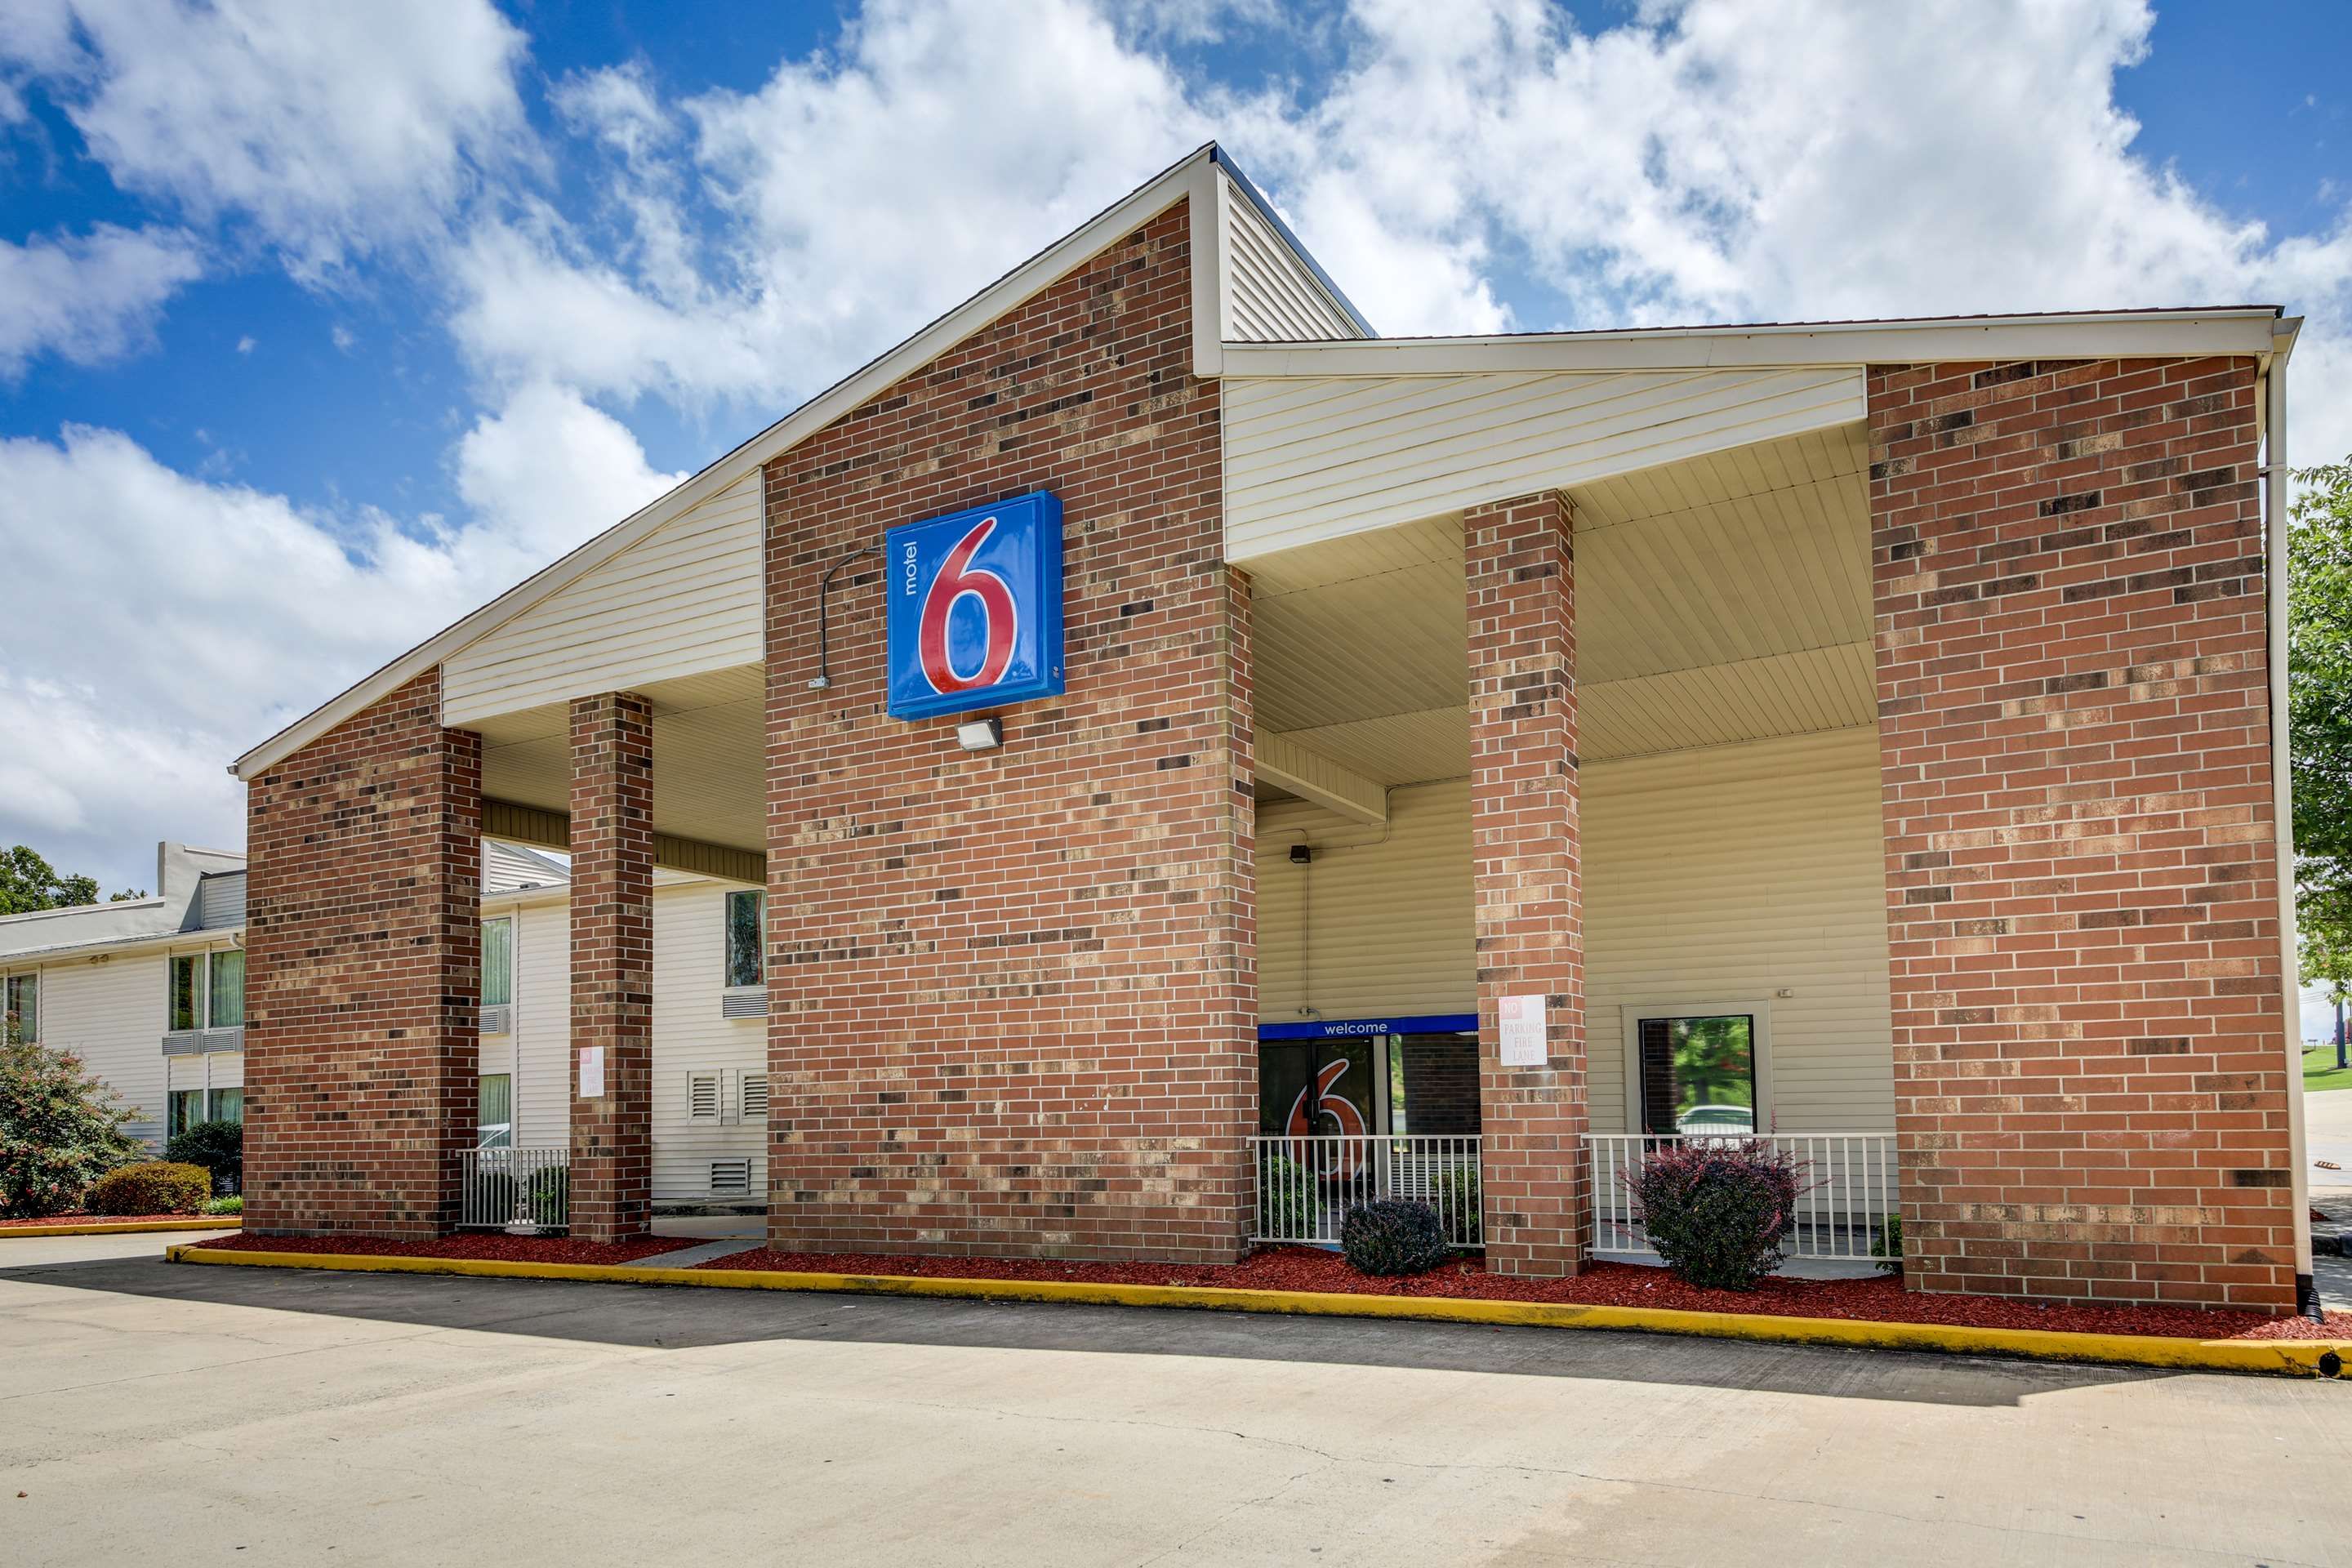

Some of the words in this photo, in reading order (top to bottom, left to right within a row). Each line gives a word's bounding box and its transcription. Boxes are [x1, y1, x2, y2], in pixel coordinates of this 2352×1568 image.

[902, 541, 917, 596] motel
[918, 516, 1018, 694] 6
[1504, 1003, 1517, 1013] NO
[1325, 1022, 1388, 1035] welcome
[1503, 1022, 1543, 1035] PARKING
[1512, 1050, 1536, 1062] LANE
[1285, 1058, 1368, 1181] 6
